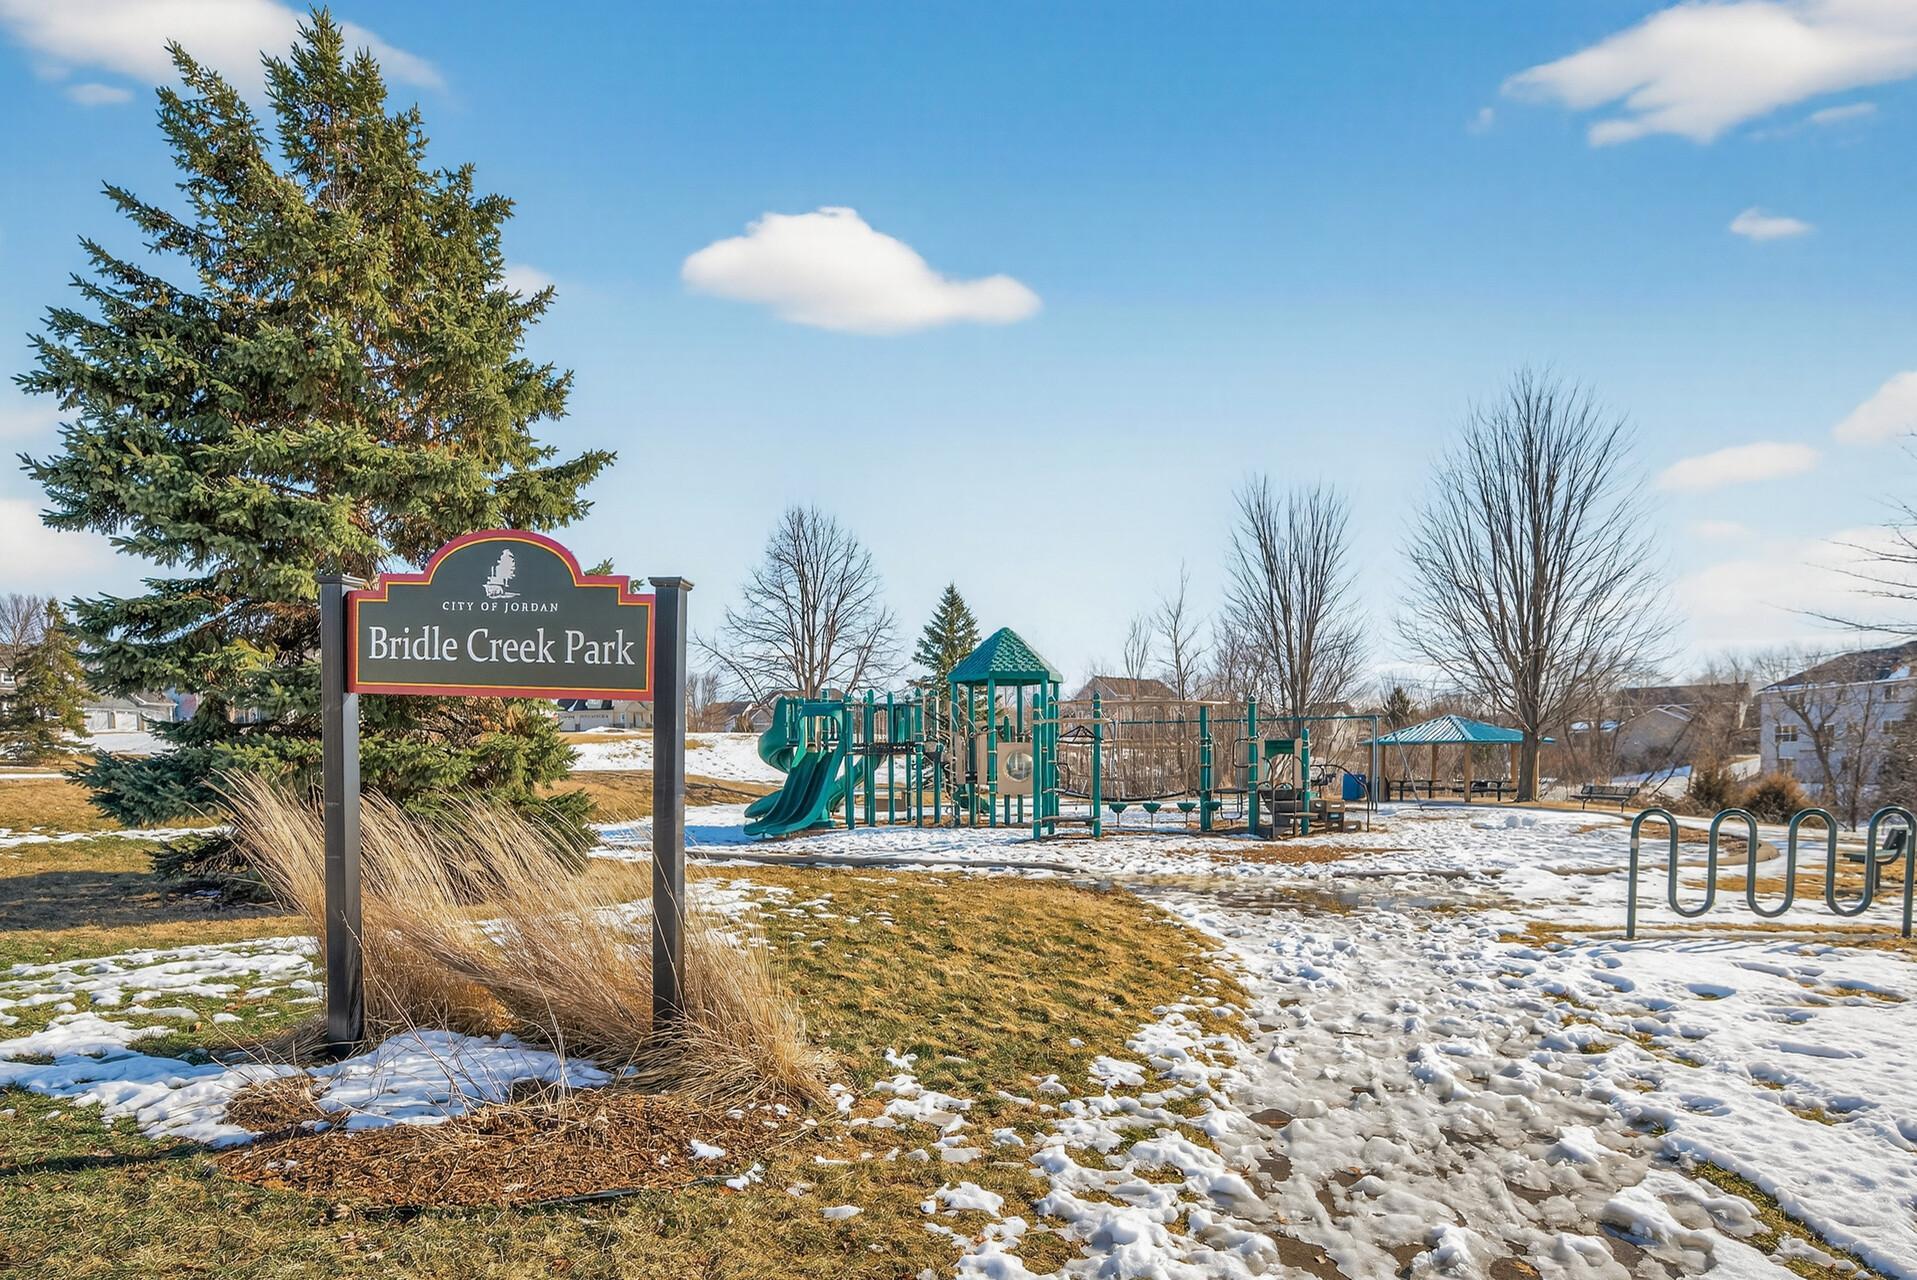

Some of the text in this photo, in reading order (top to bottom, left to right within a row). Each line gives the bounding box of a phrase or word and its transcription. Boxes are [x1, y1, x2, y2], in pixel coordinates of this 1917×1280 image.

[442, 601, 559, 613] CITY OF JORDAN
[368, 624, 635, 665] Bridle Creek Park
